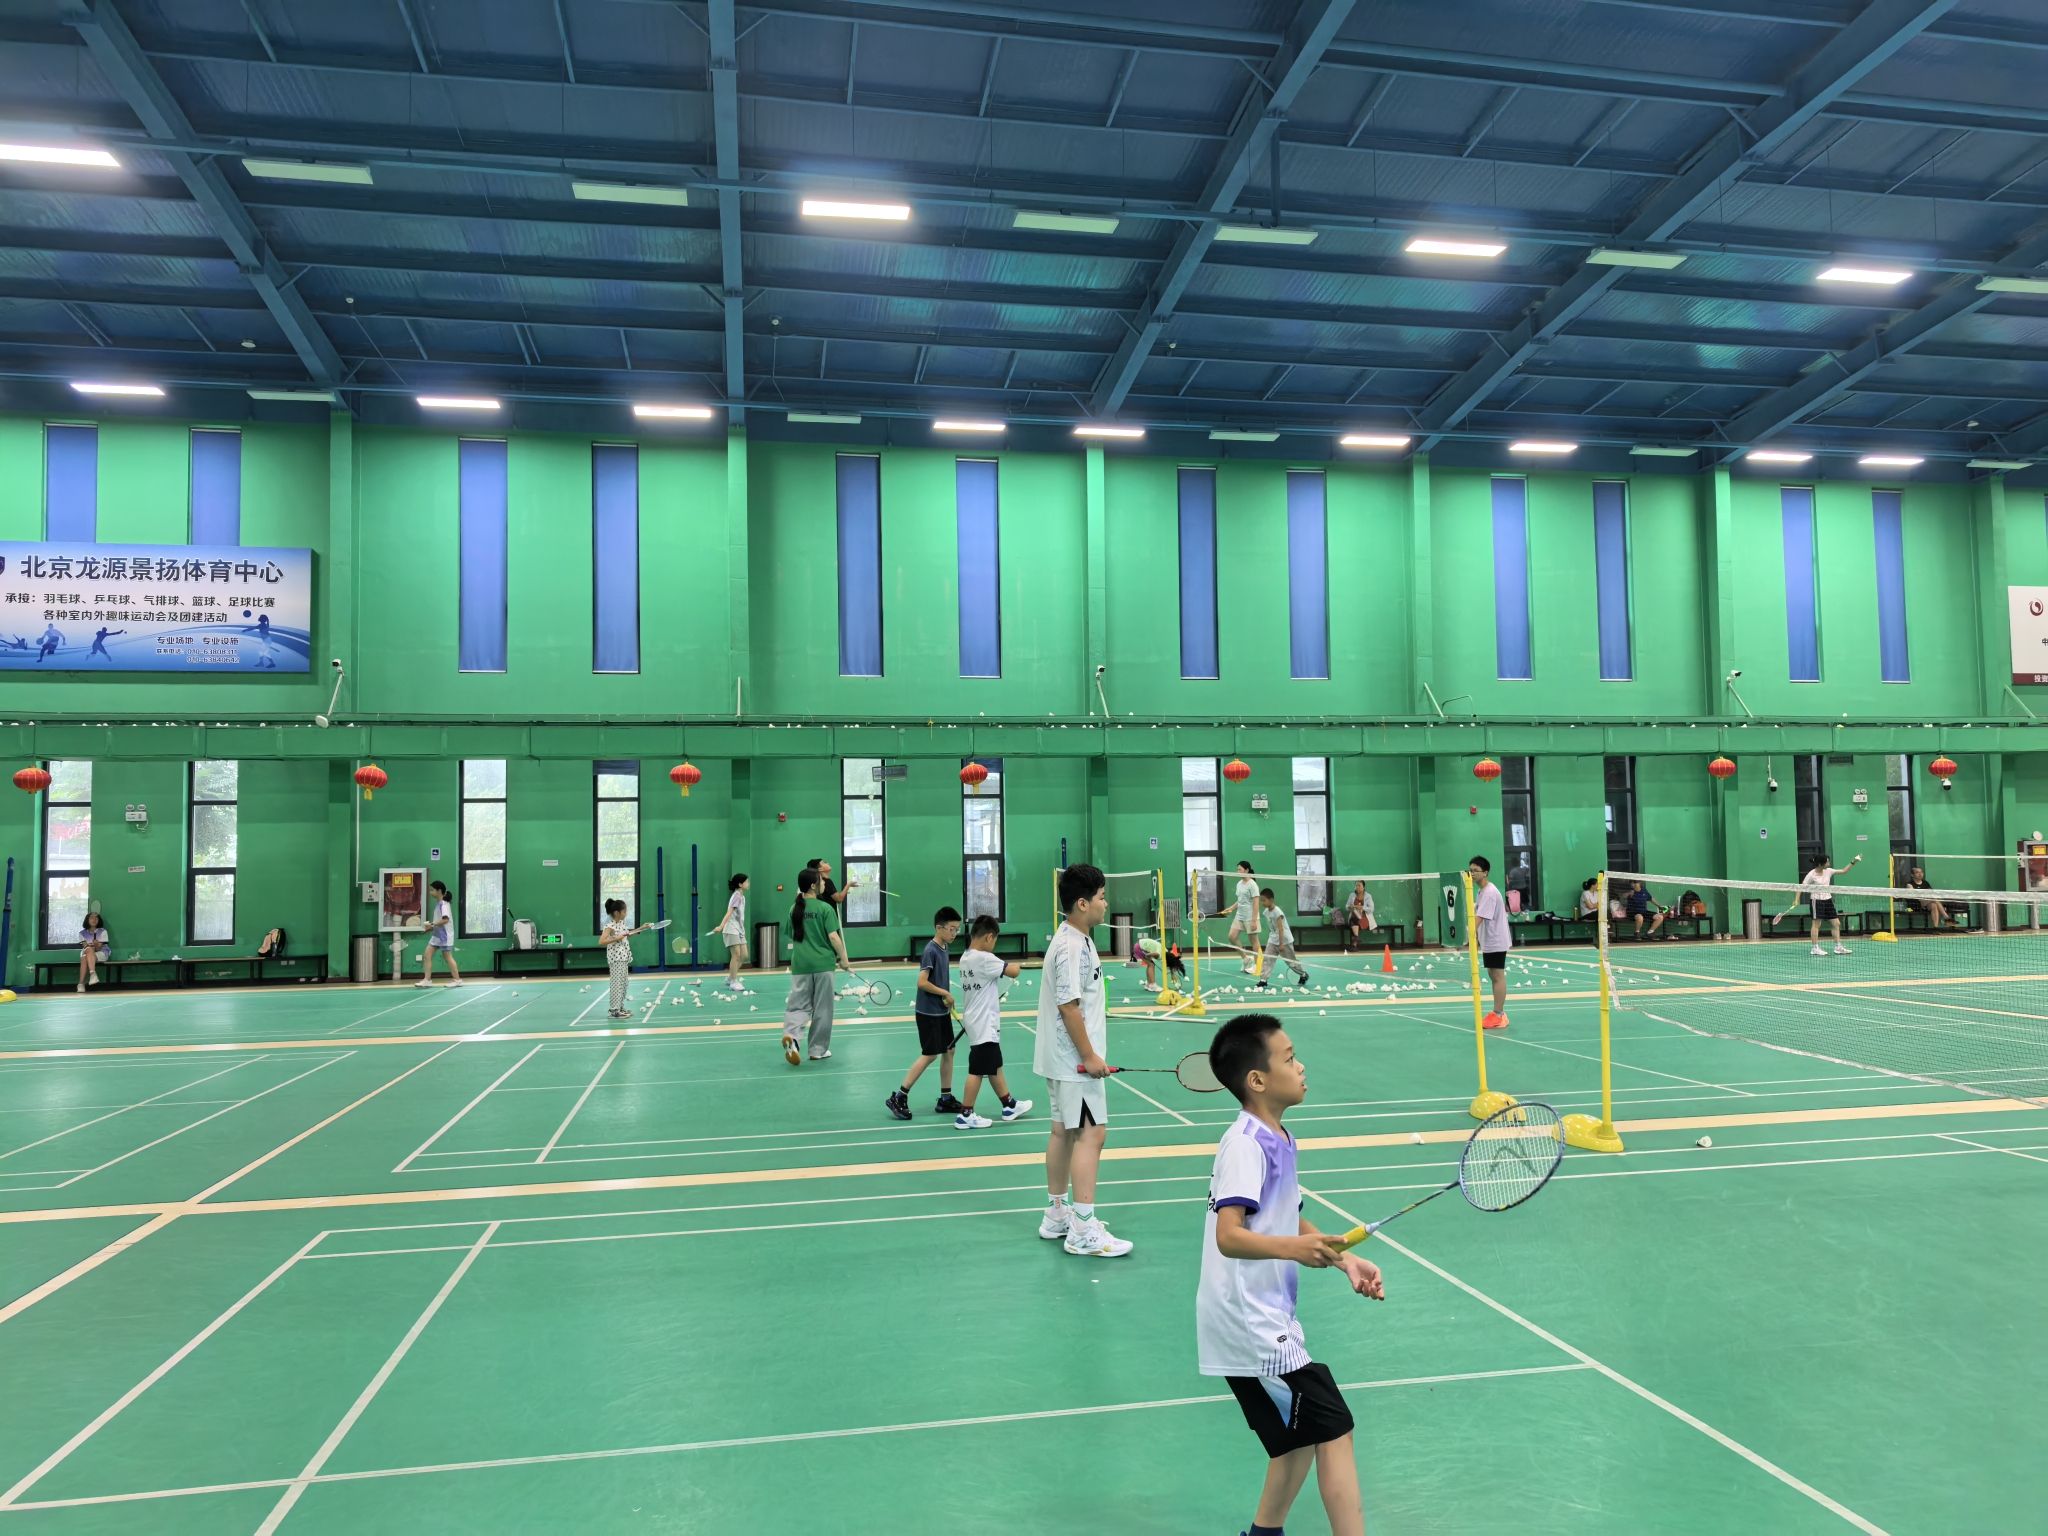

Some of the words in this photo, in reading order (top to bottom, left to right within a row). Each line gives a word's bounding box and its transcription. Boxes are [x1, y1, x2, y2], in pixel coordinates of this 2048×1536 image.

[20, 555, 284, 583] 北京龙源景扬体育中心
[43, 609, 228, 623] 各种室内外趣味运动会及团建活动
[1447, 889, 1455, 908] 6
